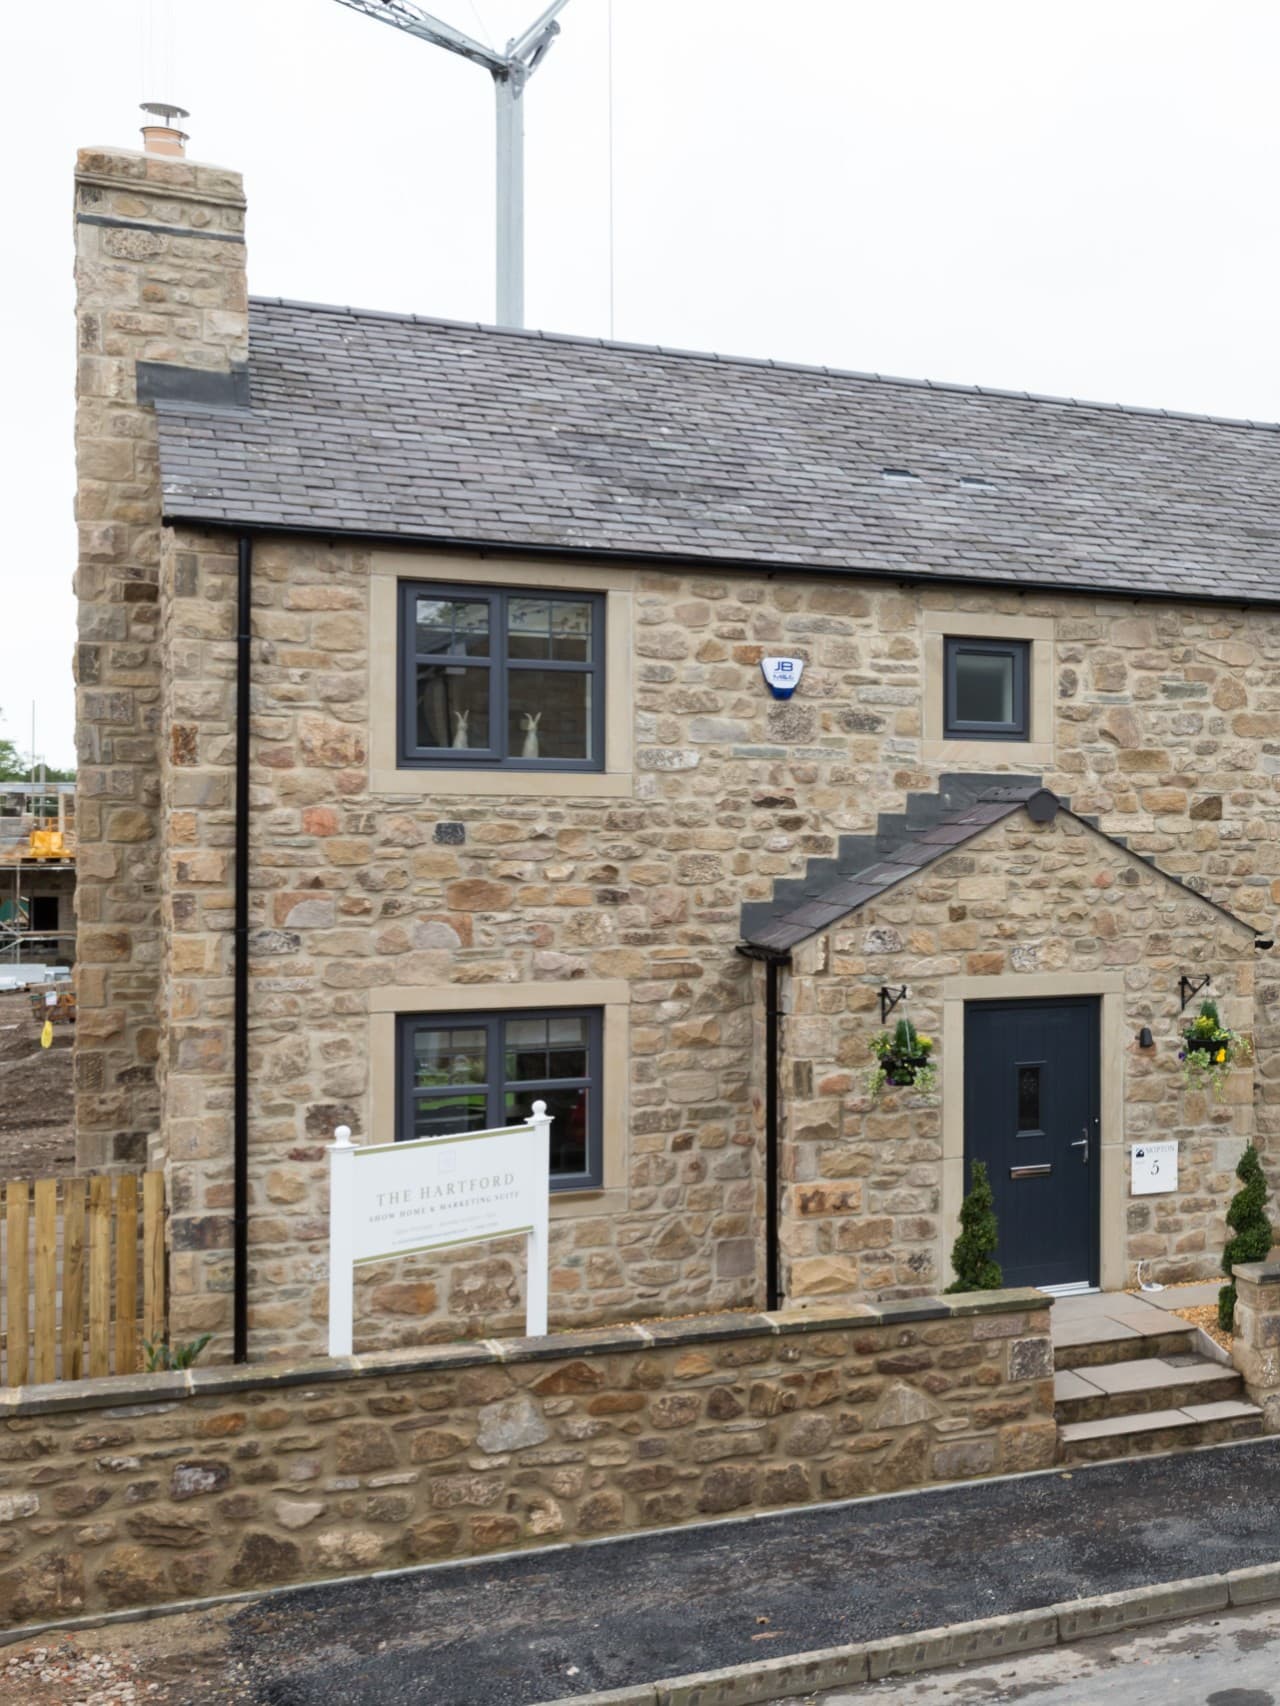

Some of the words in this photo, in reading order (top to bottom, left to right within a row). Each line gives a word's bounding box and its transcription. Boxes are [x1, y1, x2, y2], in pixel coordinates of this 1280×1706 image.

[774, 661, 793, 671] JB
[1150, 1160, 1160, 1175] 5
[376, 1189, 412, 1207] THE
[420, 1173, 515, 1200] HARTFORD
[369, 1212, 396, 1223] SHOW
[399, 1207, 426, 1217] HOME
[440, 1196, 491, 1210] MARKETING
[495, 1191, 519, 1201] SUITE
